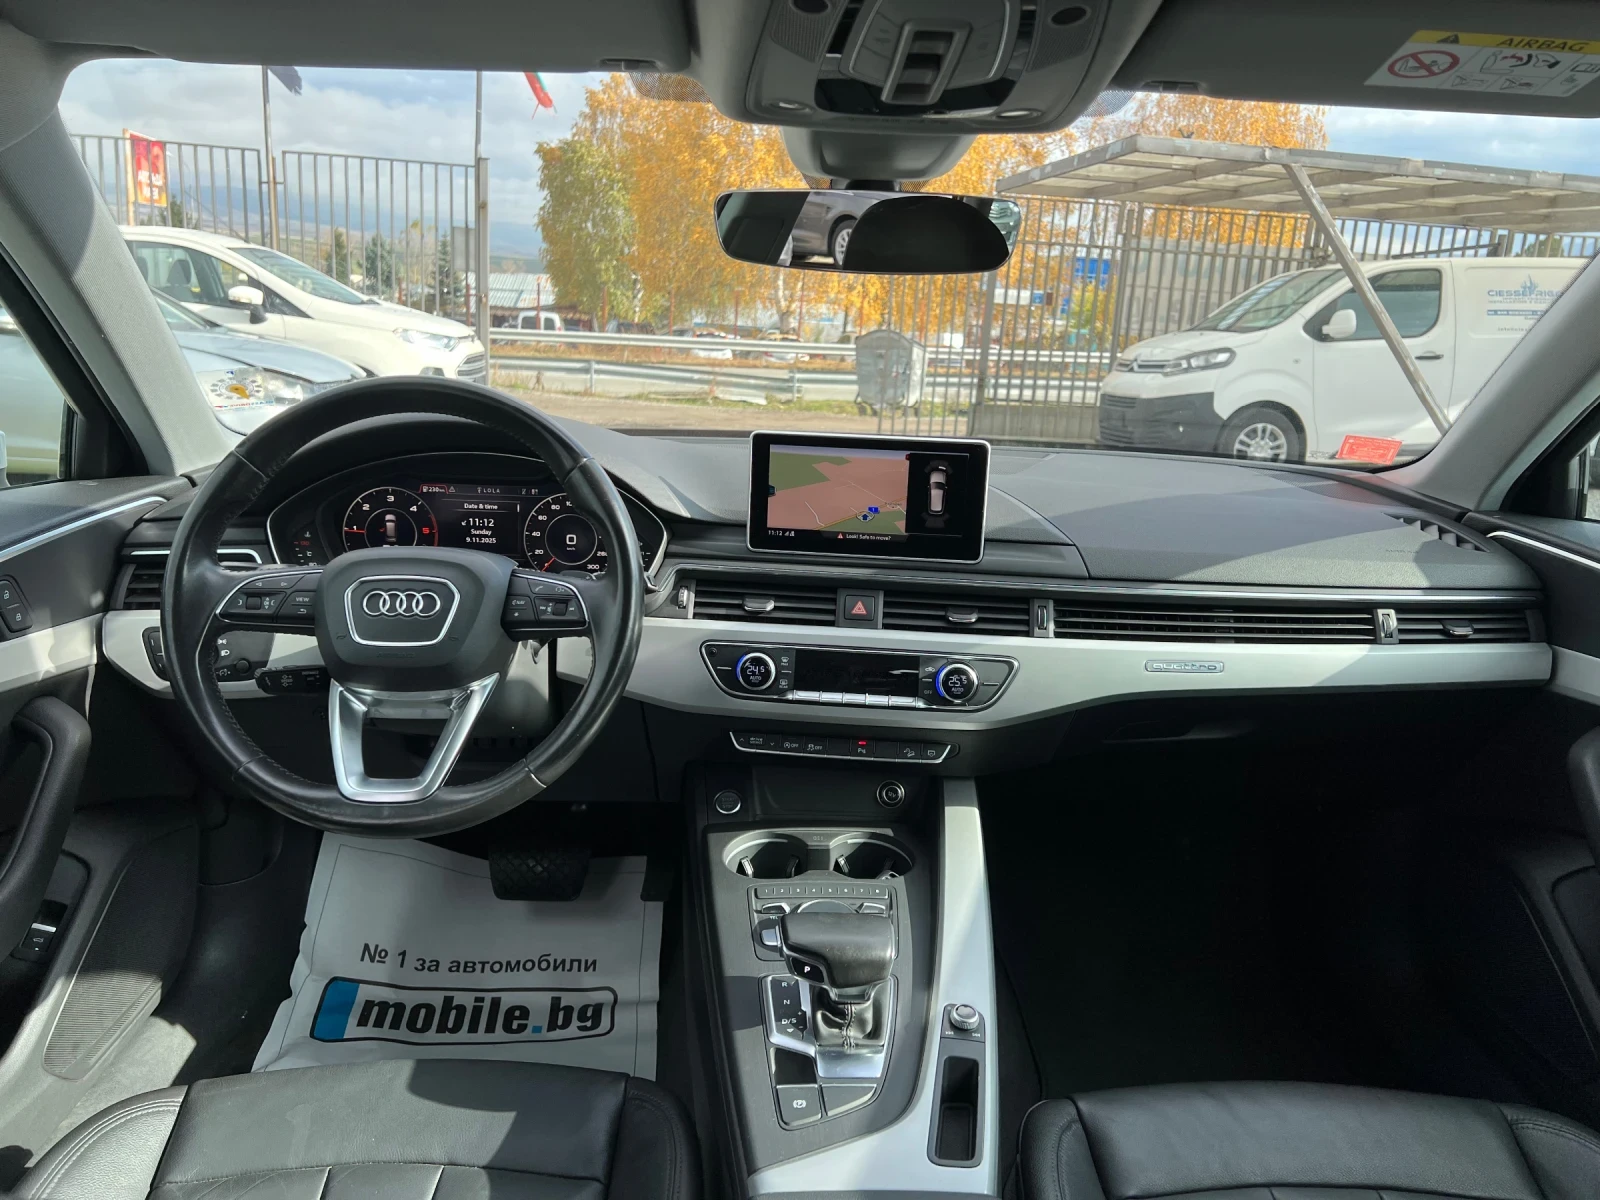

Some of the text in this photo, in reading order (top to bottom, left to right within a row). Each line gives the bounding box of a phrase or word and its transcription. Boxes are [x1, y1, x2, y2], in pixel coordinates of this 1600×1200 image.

[1497, 37, 1589, 52] AIRBAG
[362, 503, 370, 511] 2
[469, 518, 495, 527] 11:12
[470, 528, 492, 536] Sunday
[565, 534, 577, 545] 0
[1152, 663, 1217, 671] quattro
[396, 949, 407, 969] 1
[414, 958, 440, 973] за
[448, 953, 598, 974] автомобили
[356, 995, 605, 1035] mobile.bg
